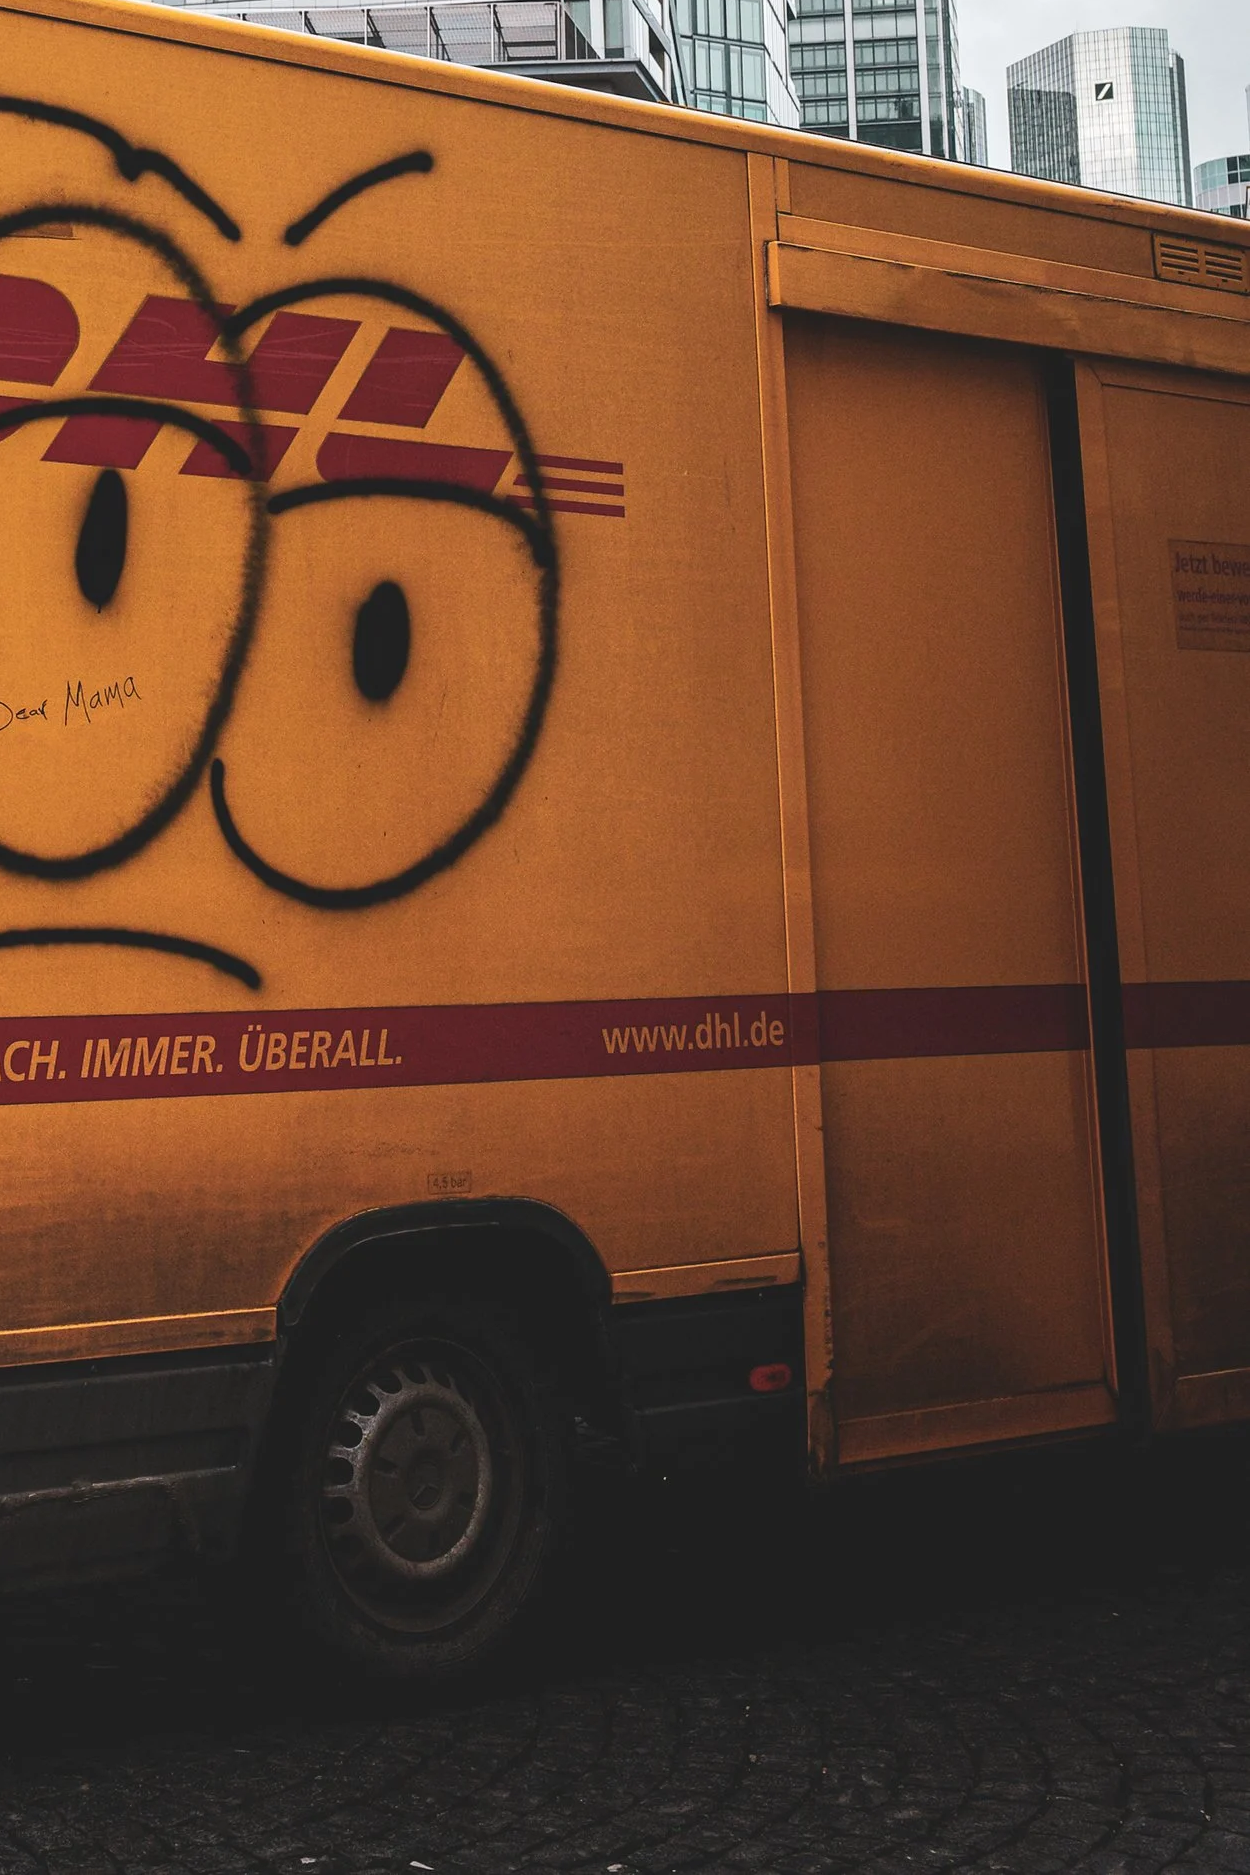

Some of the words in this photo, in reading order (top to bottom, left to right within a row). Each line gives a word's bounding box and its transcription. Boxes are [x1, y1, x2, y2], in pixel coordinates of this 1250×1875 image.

[1175, 552, 1209, 575] Jetzt
[64, 676, 142, 726] Mama
[80, 1034, 224, 1079] IMMER.
[238, 1025, 403, 1073] ÜBERALL.
[601, 1010, 785, 1054] www.dhl.de
